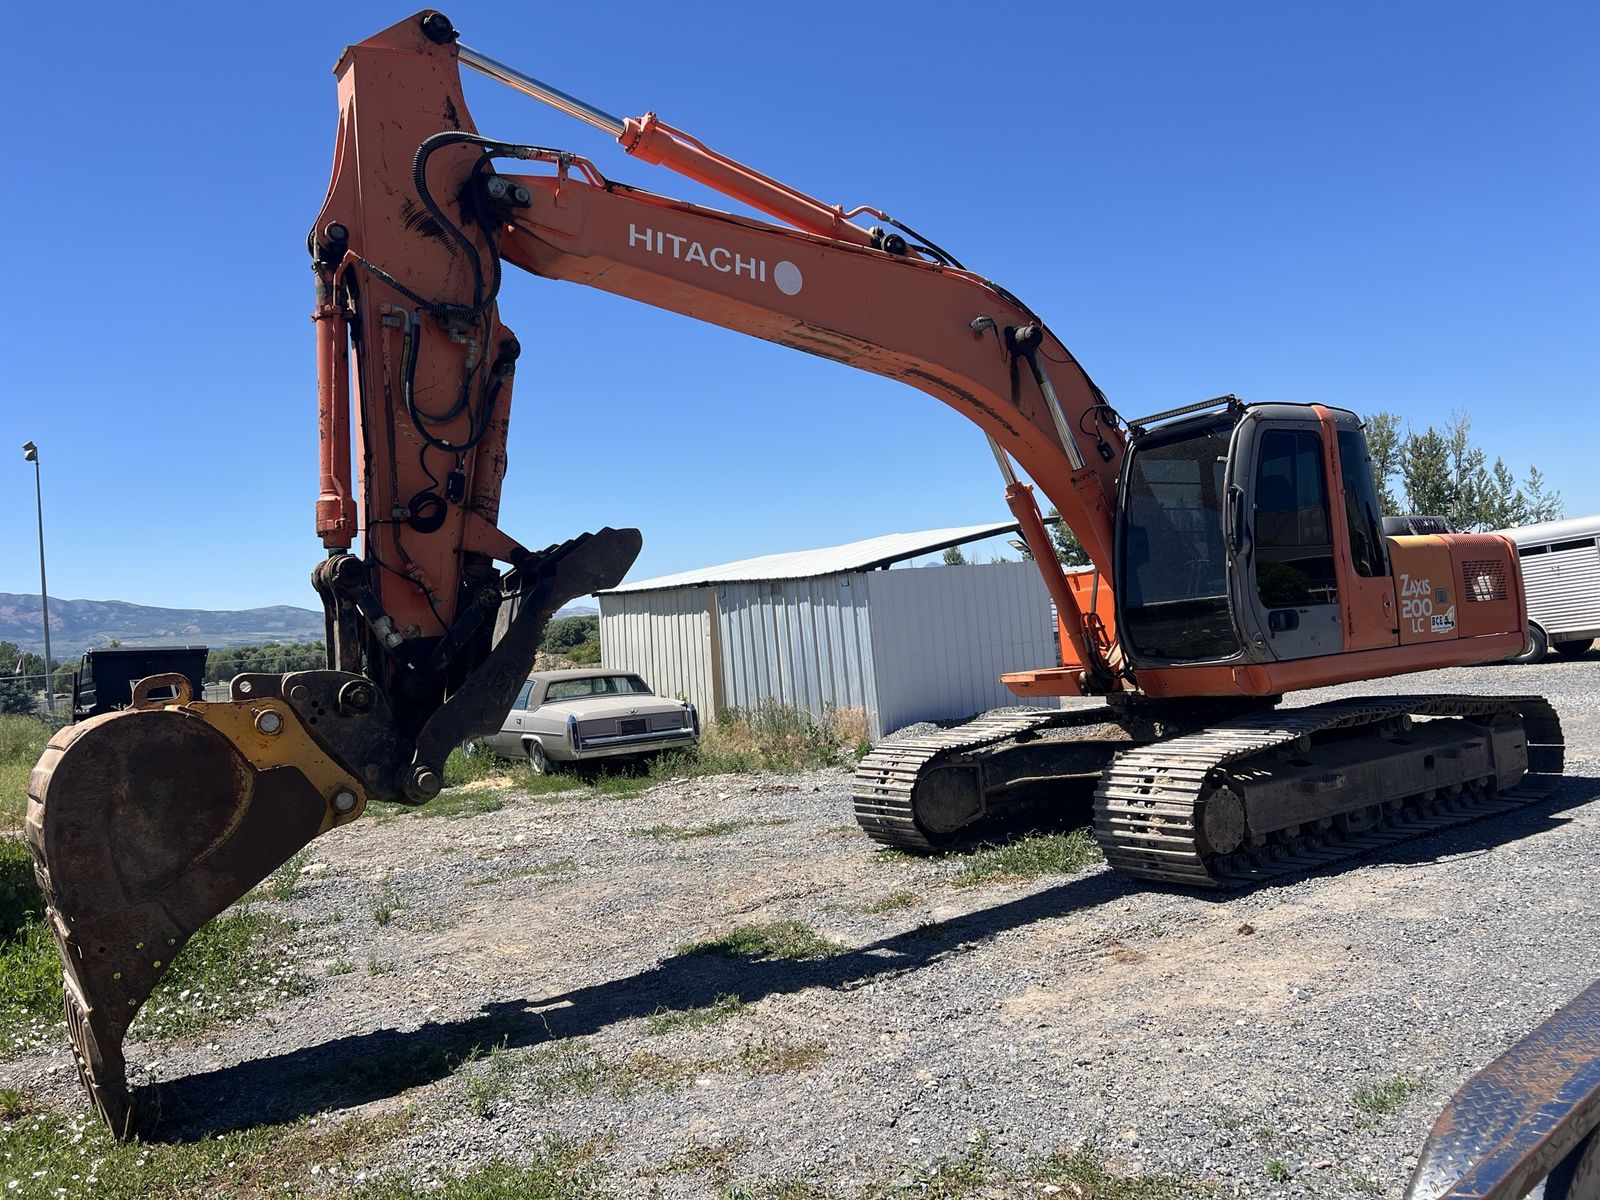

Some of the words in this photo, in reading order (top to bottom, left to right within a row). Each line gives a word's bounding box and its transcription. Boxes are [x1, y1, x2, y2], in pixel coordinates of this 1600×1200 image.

[629, 223, 766, 283] HITACHI
[1402, 598, 1432, 618] 200
[1412, 618, 1424, 633] LC
